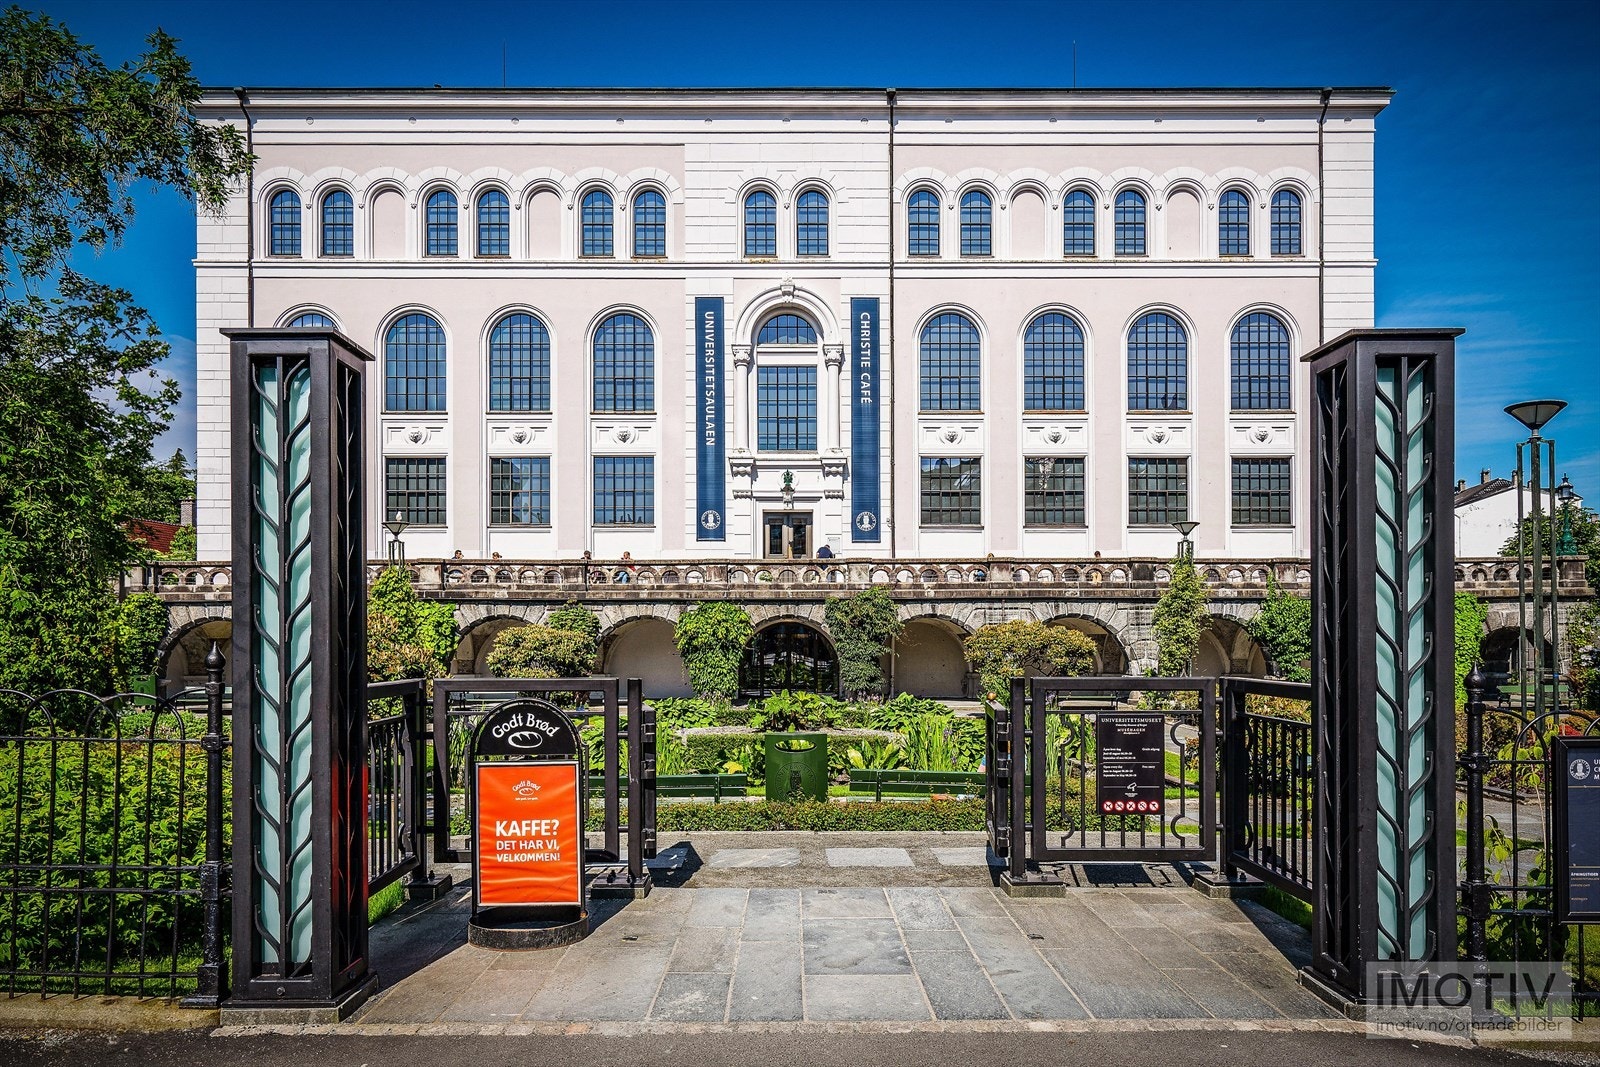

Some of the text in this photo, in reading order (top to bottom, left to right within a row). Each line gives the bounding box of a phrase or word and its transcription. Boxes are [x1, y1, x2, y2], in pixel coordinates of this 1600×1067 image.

[860, 312, 872, 404] CHRISTIE CAFÉ
[704, 311, 716, 446] UNIVERSITETSAULAEN
[492, 712, 560, 738] Godt Brød
[512, 780, 526, 791] Godt
[495, 819, 560, 837] KAFFE?
[496, 839, 560, 851] DET HAR VI,
[496, 852, 560, 862] VELKOMMEN!
